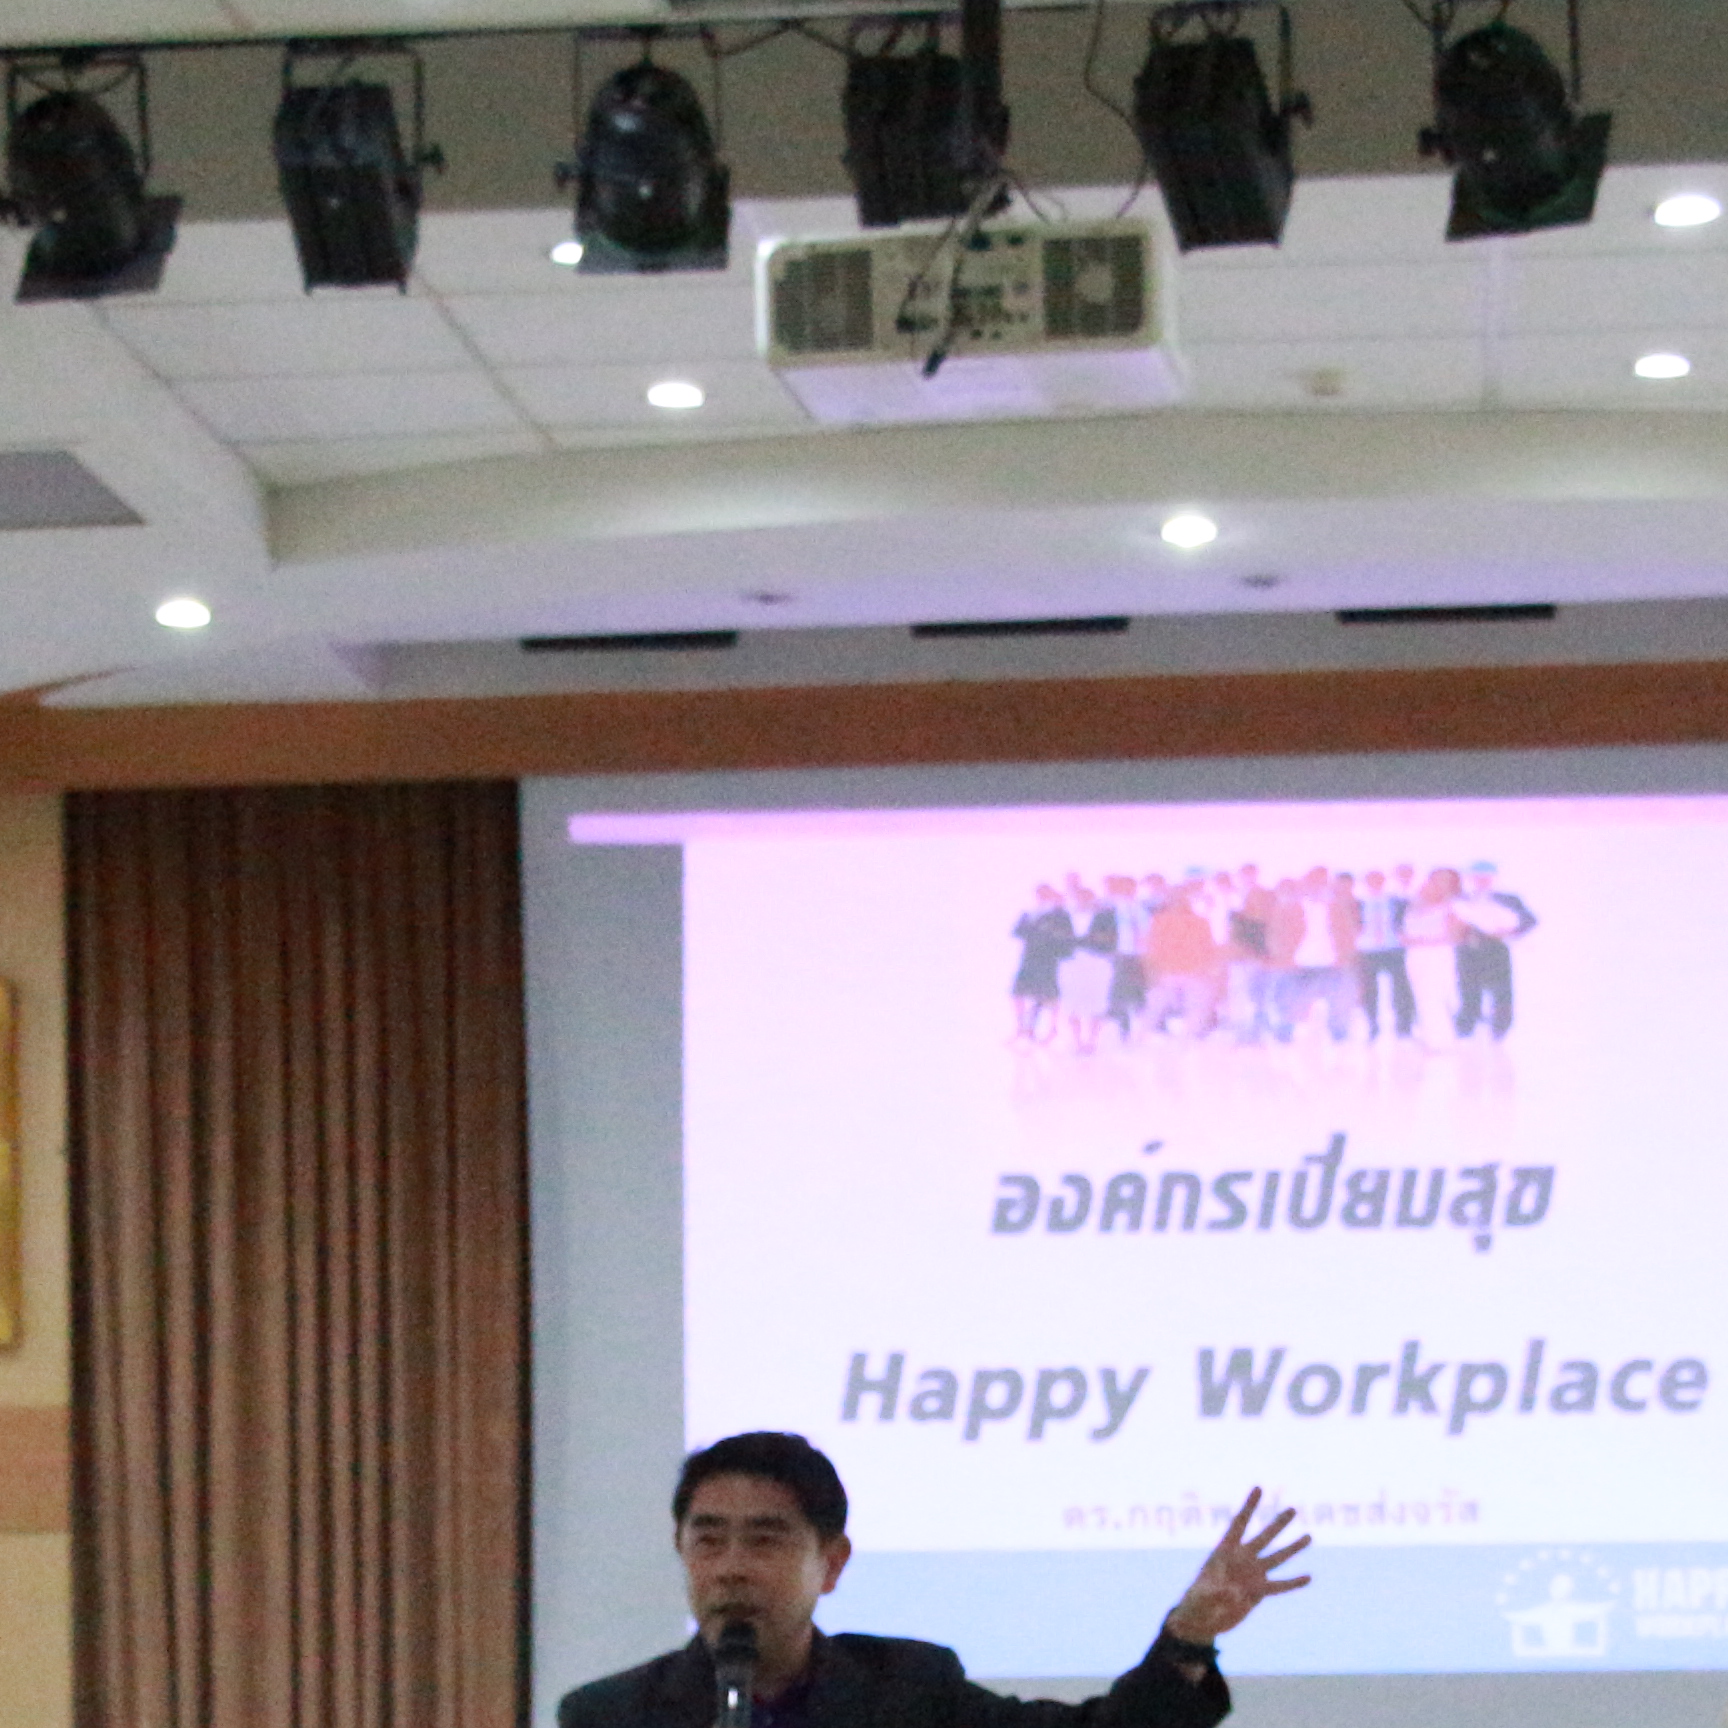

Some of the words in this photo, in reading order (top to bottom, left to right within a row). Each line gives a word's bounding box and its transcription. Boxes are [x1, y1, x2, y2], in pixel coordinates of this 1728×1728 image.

[990, 1131, 1556, 1253] องค์กรเปี่ยมสุข
[841, 1351, 1150, 1441] Happy
[1197, 1338, 1709, 1436] Workplace
